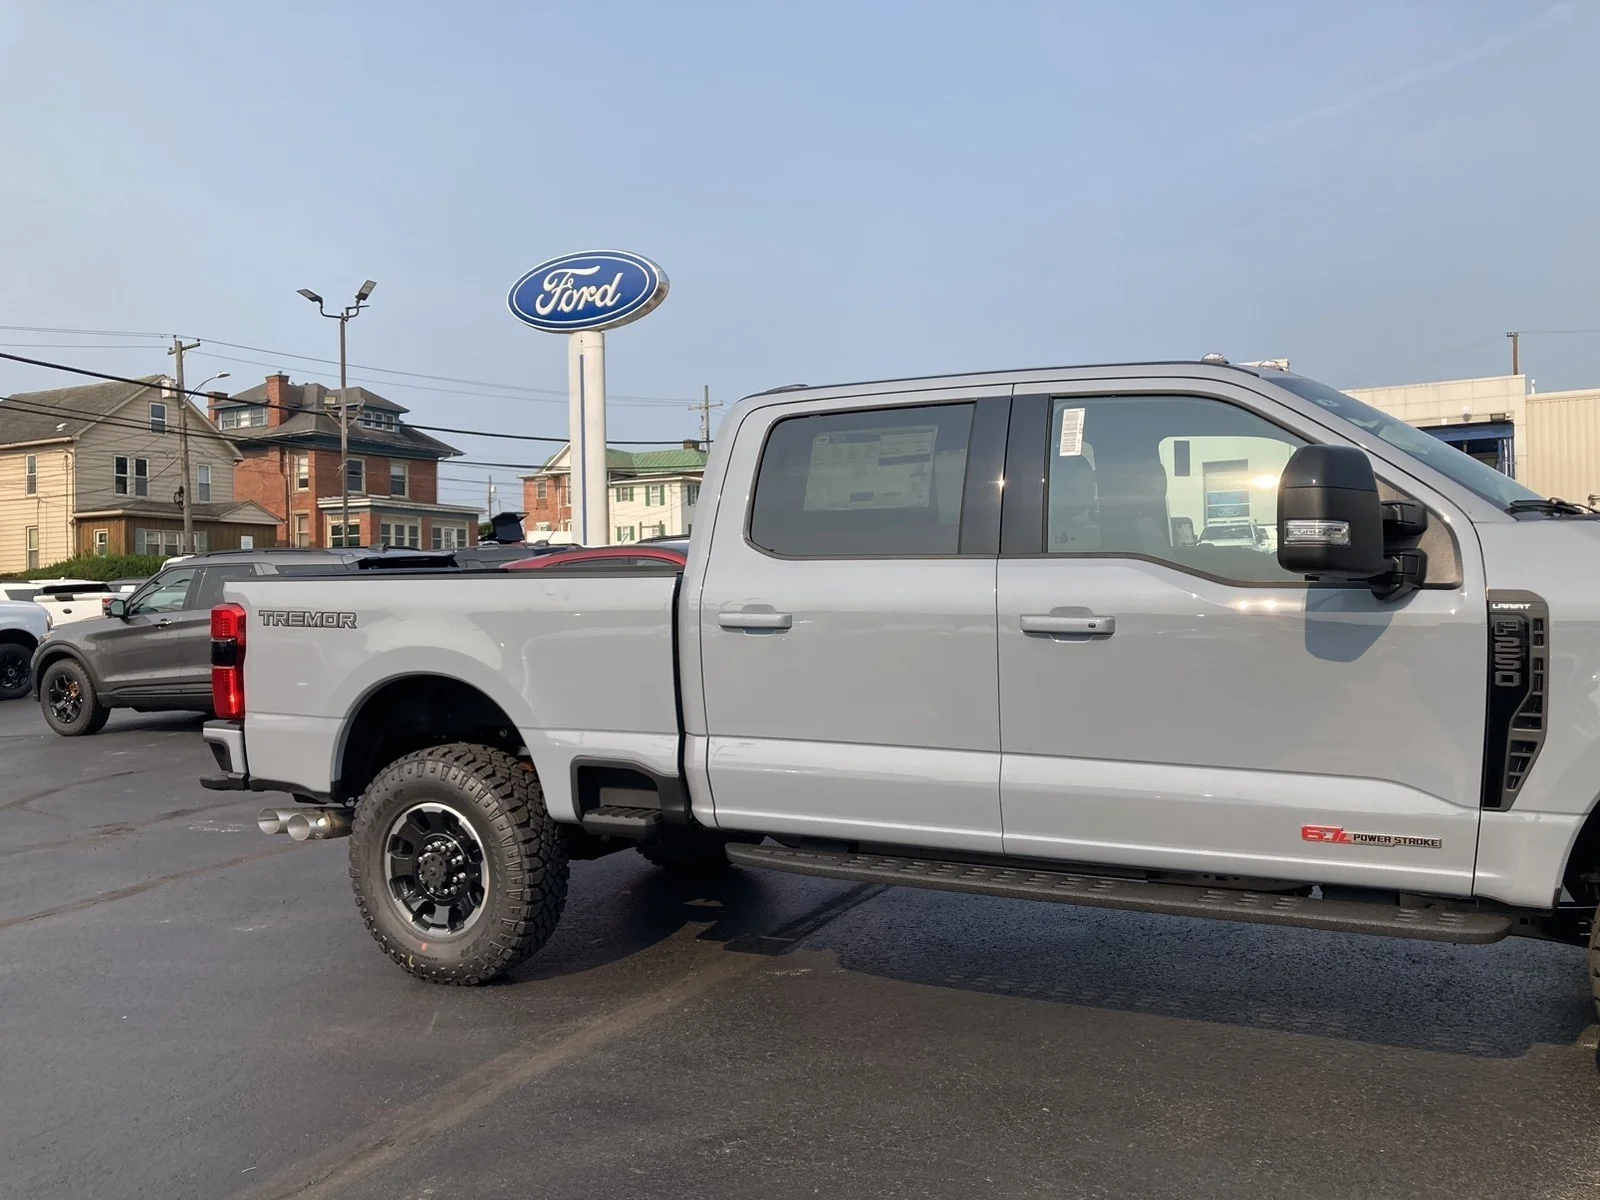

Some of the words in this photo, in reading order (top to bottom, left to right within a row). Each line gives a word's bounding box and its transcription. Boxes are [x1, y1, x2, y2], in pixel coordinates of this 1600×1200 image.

[535, 265, 623, 315] Ford
[259, 610, 357, 629] TREMOR
[1494, 620, 1521, 687] F250
[1353, 833, 1392, 844] POWER
[1394, 836, 1439, 847] STROKE
